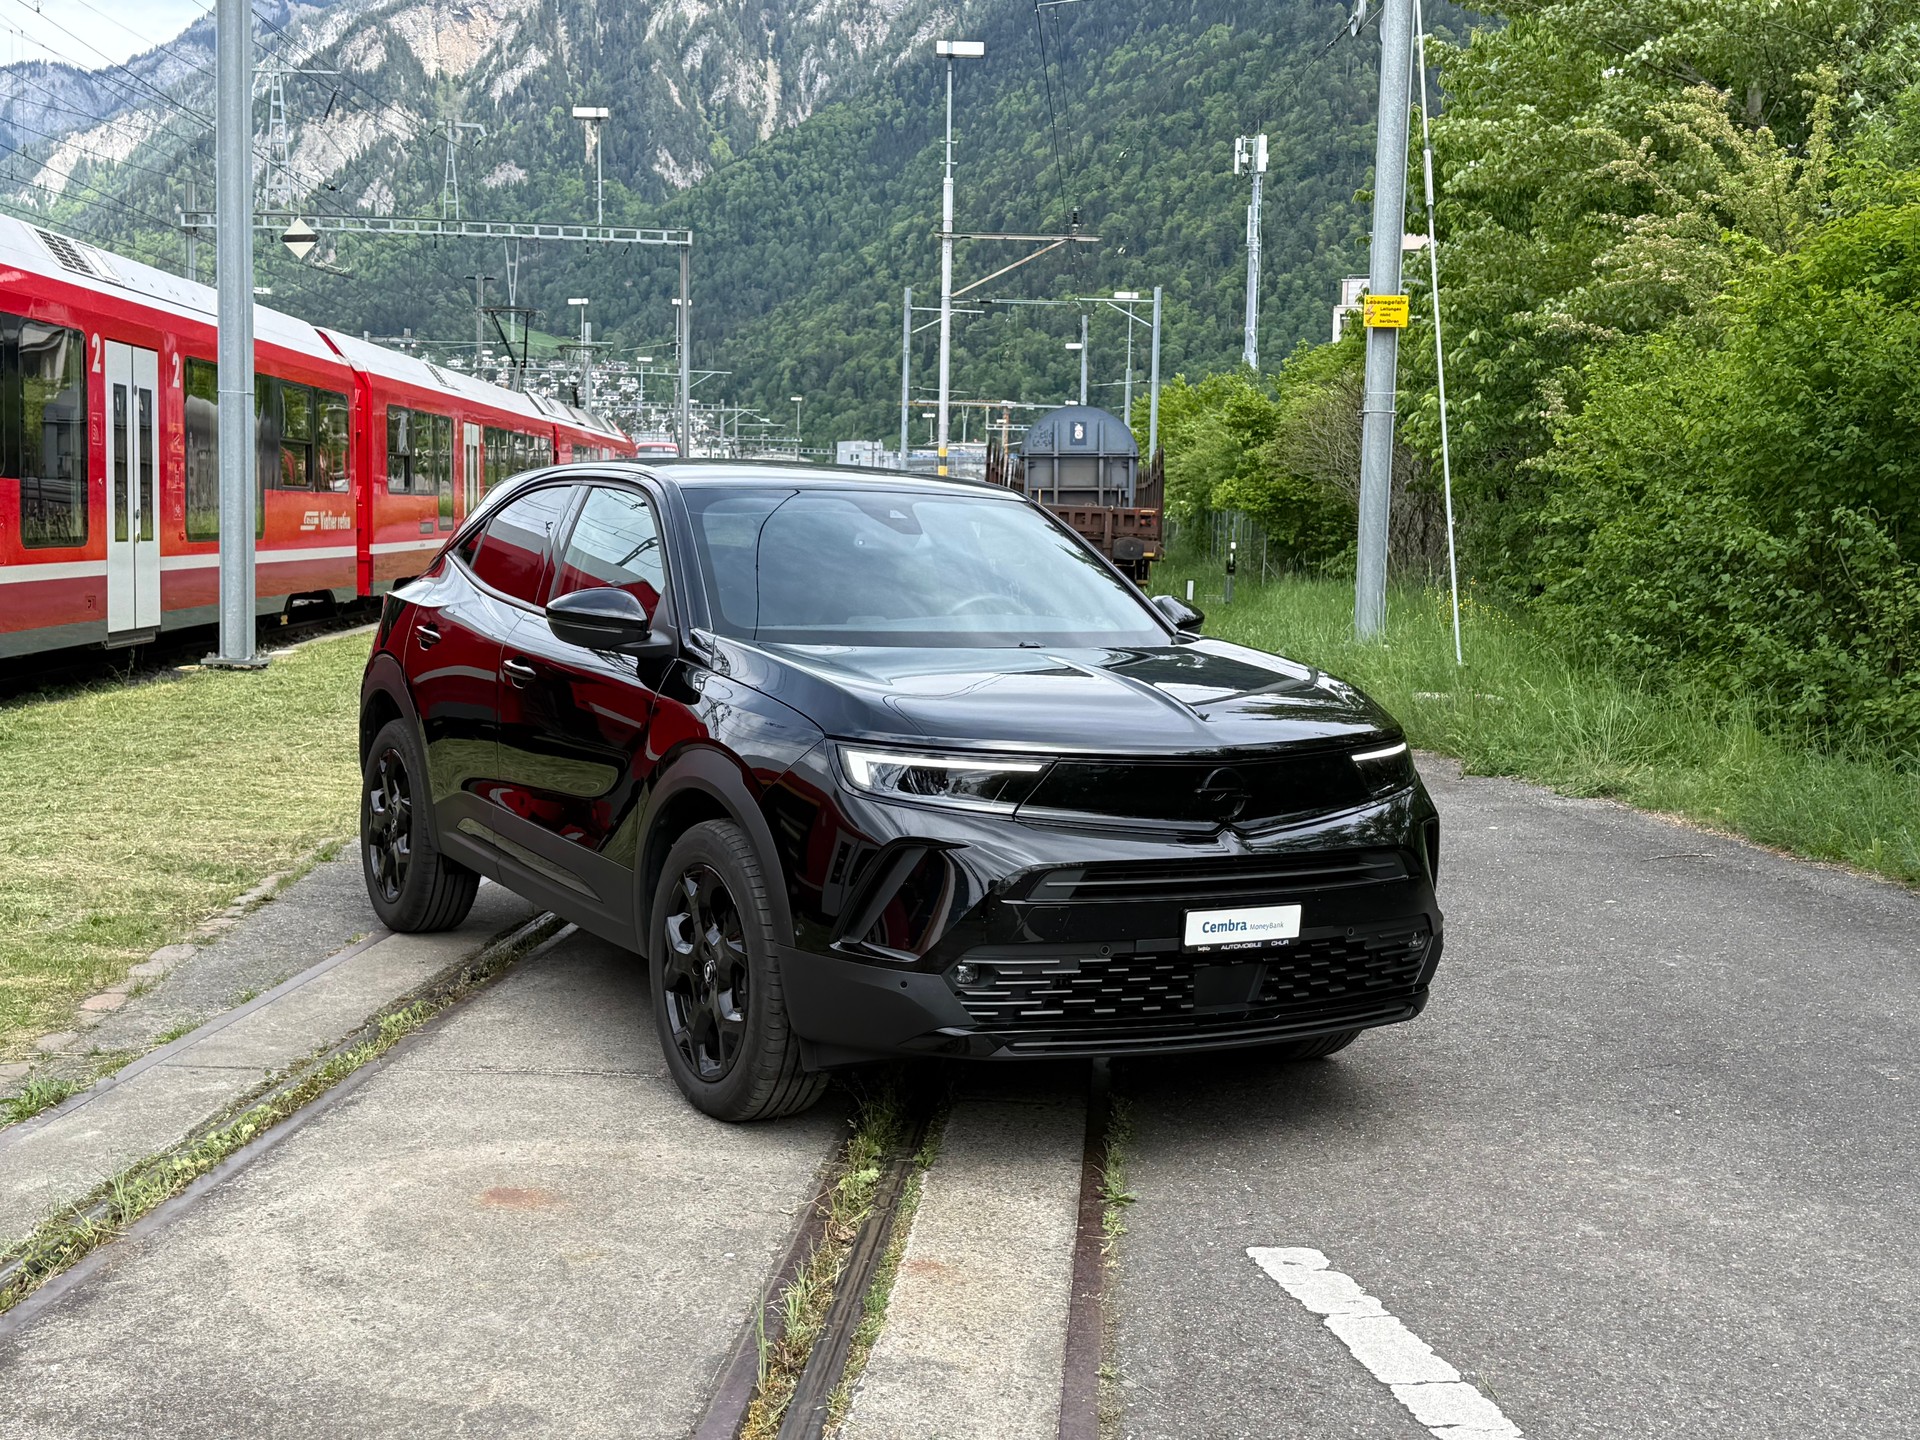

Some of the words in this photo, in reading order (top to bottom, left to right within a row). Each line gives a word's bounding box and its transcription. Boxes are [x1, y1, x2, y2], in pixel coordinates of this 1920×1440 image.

[91, 333, 101, 374] 2
[172, 352, 180, 389] 2
[1202, 919, 1247, 933] Cembra
[1249, 922, 1284, 931] MoneyBank
[1221, 942, 1261, 951] AUTOMOBILE
